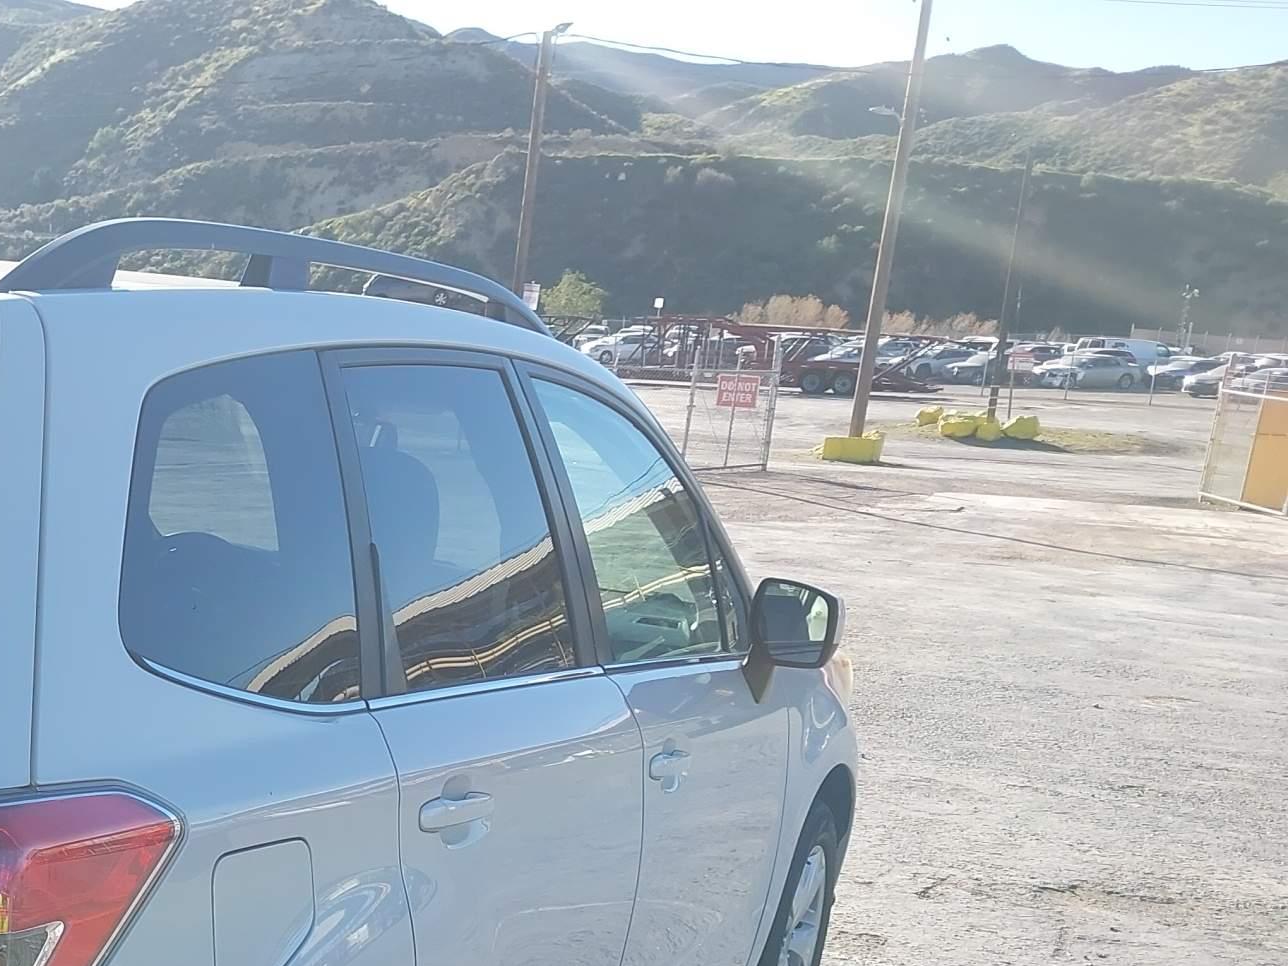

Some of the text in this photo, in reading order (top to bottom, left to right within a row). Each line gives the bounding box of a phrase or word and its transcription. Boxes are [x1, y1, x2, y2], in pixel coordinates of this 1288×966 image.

[721, 381, 756, 392] DO NOT
[721, 392, 752, 403] ENTER
